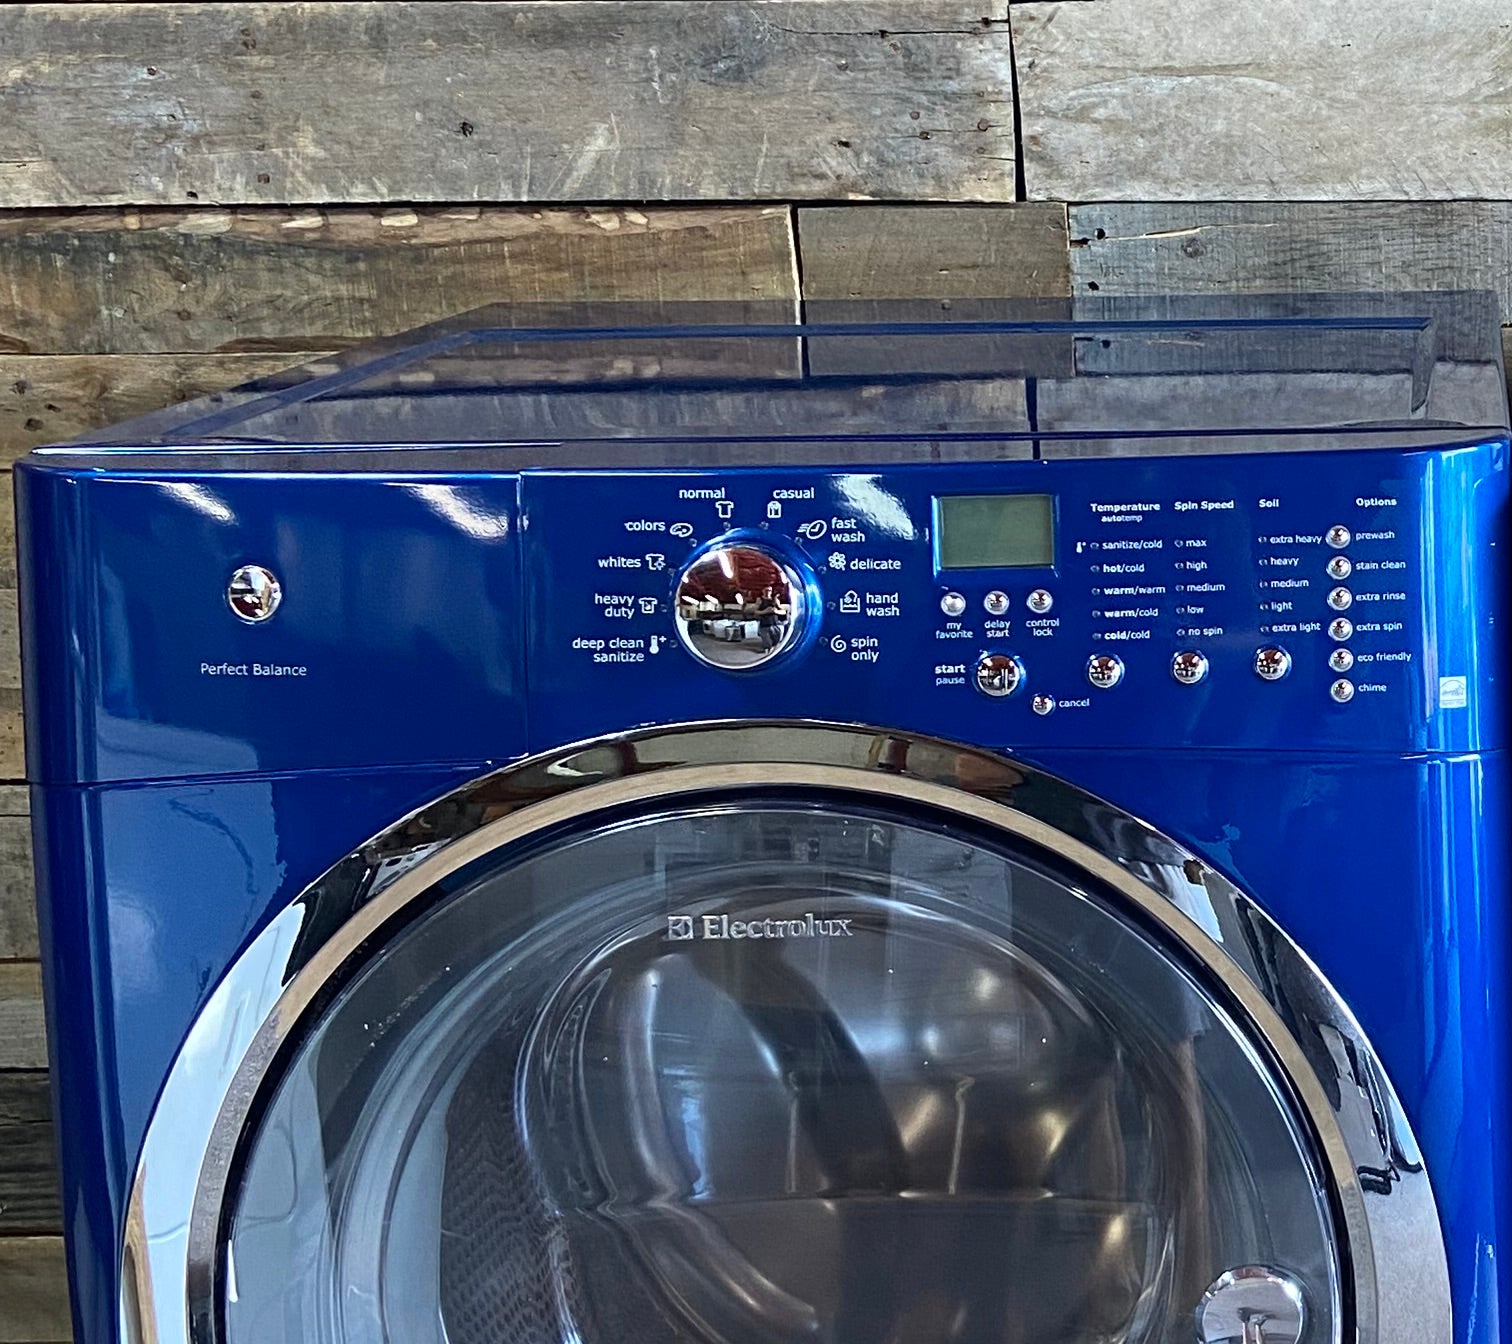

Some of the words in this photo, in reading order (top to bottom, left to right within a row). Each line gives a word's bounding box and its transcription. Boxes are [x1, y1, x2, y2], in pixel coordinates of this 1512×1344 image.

[679, 487, 725, 499] normal
[773, 487, 815, 499] casual
[1090, 502, 1161, 514] Temperature
[1174, 501, 1200, 512] Spin
[1202, 500, 1234, 512] Speed
[1259, 498, 1280, 508] Soil
[1356, 498, 1397, 508] Options
[625, 519, 666, 532] colors
[831, 517, 857, 530] fast
[831, 530, 866, 543] wash
[1270, 536, 1293, 544] extra
[1296, 534, 1322, 544] heavy
[1356, 531, 1395, 541] prewash
[1102, 539, 1163, 551] sanitize/cold
[1186, 538, 1207, 548] max
[597, 556, 641, 568] whites
[850, 558, 901, 570] delicate
[1186, 560, 1207, 571] high
[1270, 557, 1299, 567] heavy
[1356, 562, 1379, 570] stain
[1381, 560, 1406, 570] clean
[1103, 563, 1145, 573] hot/cold
[1187, 582, 1225, 592] medium
[1270, 579, 1309, 588] medium
[1104, 585, 1166, 596] warm/warm
[1356, 593, 1380, 601] extra
[1383, 591, 1406, 601] rinse
[594, 593, 635, 607] heavy
[866, 592, 899, 604] hand
[866, 605, 900, 617] wash
[1187, 605, 1204, 615] low
[1271, 601, 1293, 612] light
[605, 606, 635, 619] duty
[1104, 608, 1158, 618] warm/cold
[946, 622, 961, 632] my
[984, 619, 1010, 630] delay
[1026, 618, 1060, 628] control
[1272, 623, 1297, 632] extra
[1299, 622, 1321, 632] light
[1356, 623, 1381, 631] extra
[1383, 621, 1403, 632] spin
[936, 629, 973, 639] favorite
[986, 629, 1009, 638] start
[1033, 627, 1053, 637] lock
[1104, 630, 1150, 641] cold/cold
[1188, 628, 1201, 637] no
[1203, 626, 1223, 638] spin
[572, 637, 606, 651] deep
[609, 636, 644, 649] clean
[851, 635, 878, 650] spin
[593, 650, 645, 663] sanitize
[851, 649, 879, 663] only
[1357, 654, 1374, 662] eco
[1376, 652, 1412, 662] friendly
[200, 662, 248, 676] Perfect
[253, 663, 307, 676] Balance
[935, 663, 966, 674] start
[936, 676, 965, 687] pause
[1358, 683, 1387, 692] chime
[1059, 698, 1090, 707] cancel
[701, 913, 853, 940] Electrolux
